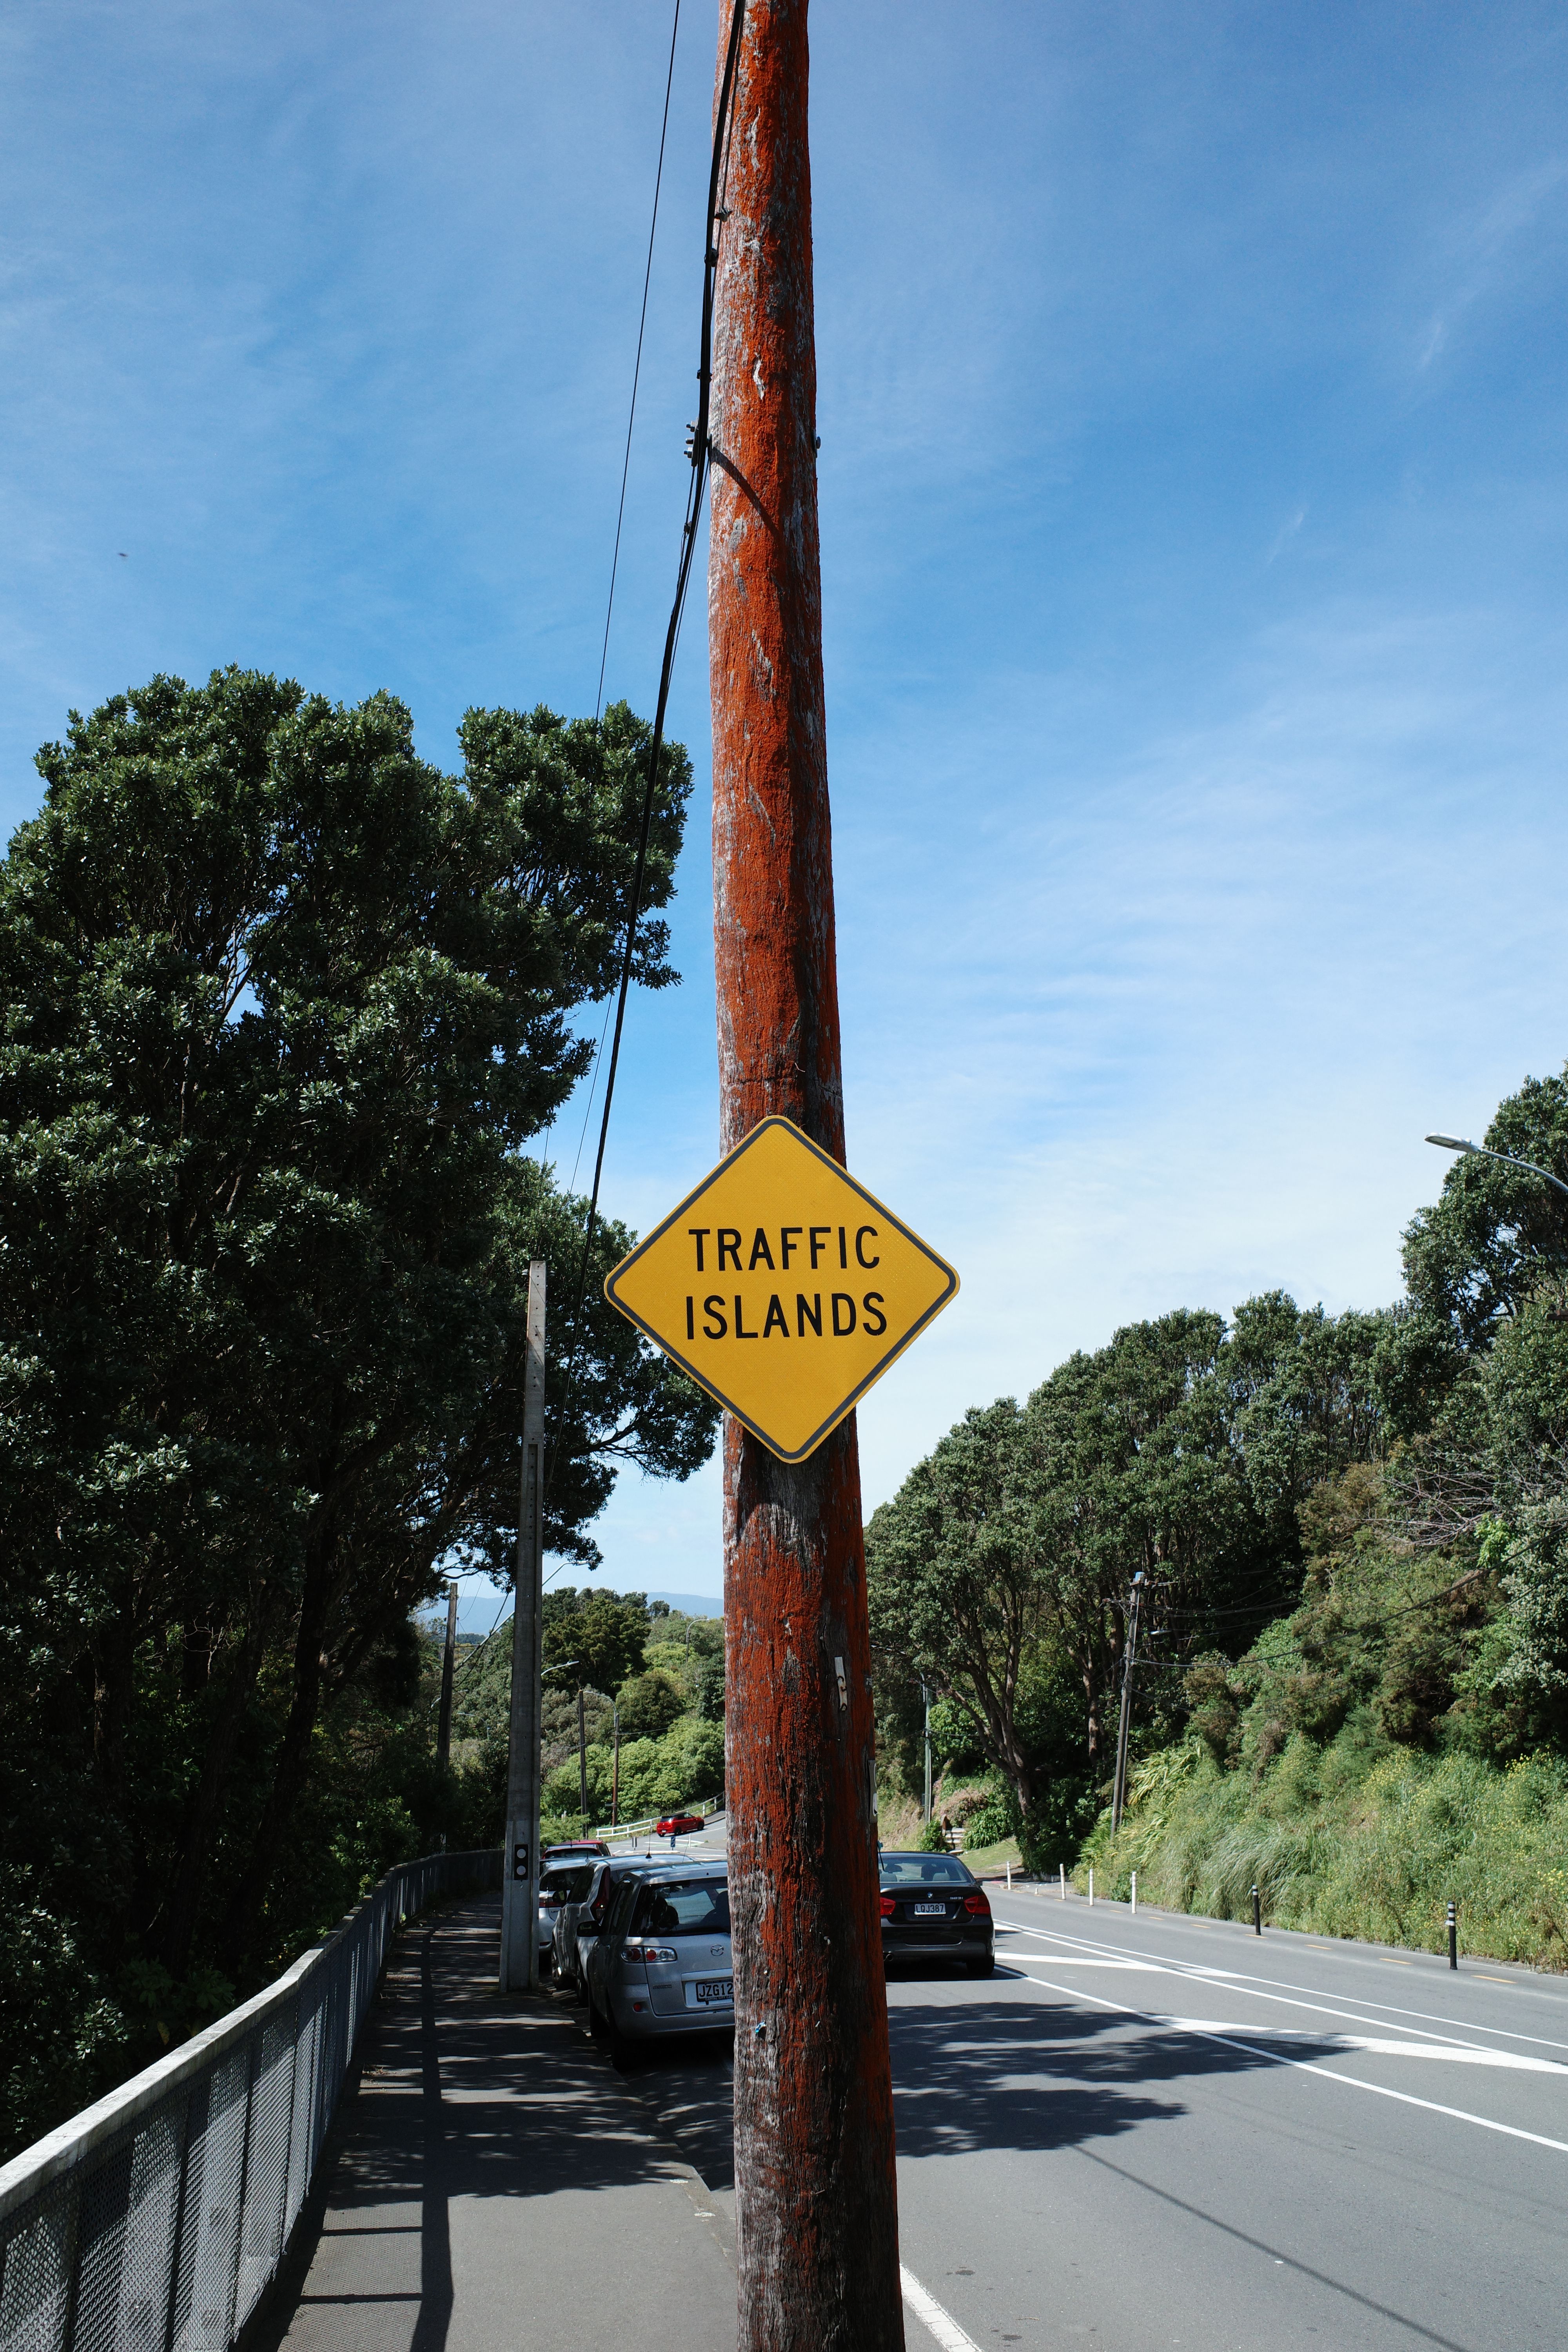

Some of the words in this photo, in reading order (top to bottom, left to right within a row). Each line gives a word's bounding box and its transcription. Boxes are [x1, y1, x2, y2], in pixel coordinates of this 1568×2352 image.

[688, 1226, 880, 1271] TRAFFIC
[686, 1292, 887, 1340] ISLANDS
[916, 1904, 944, 1913] LQJ387
